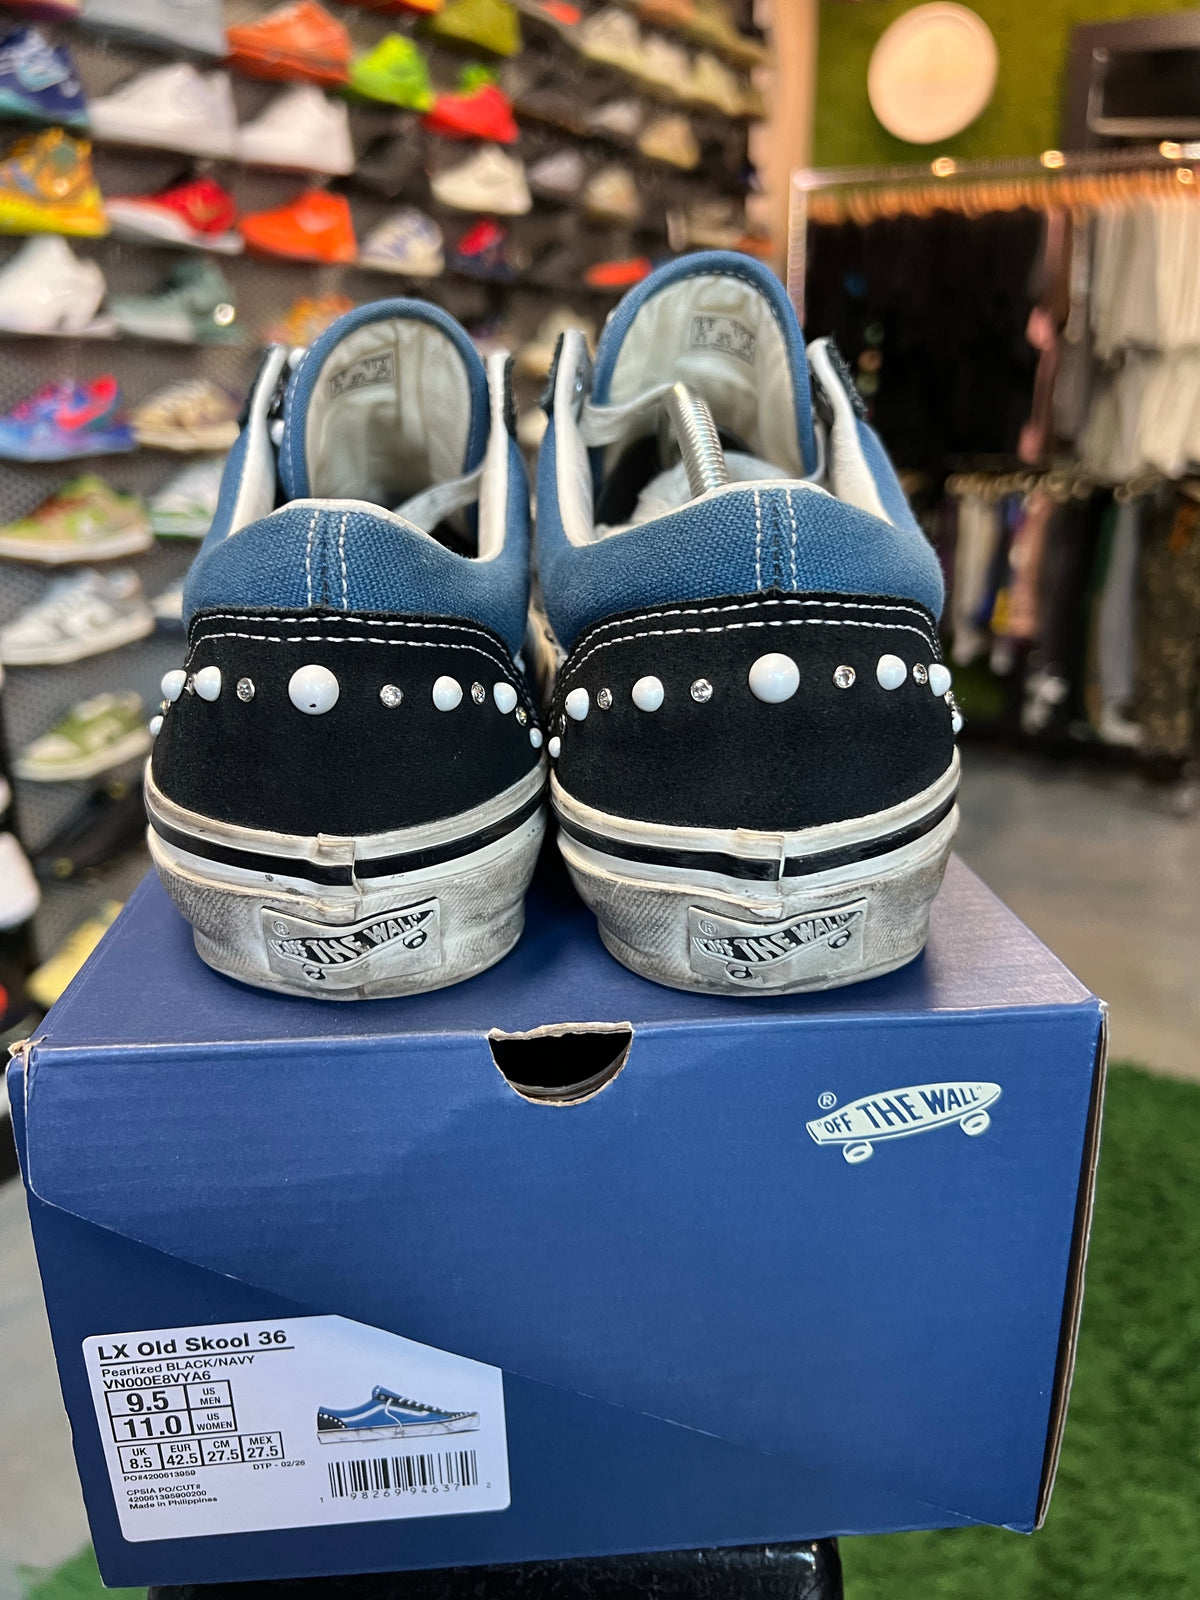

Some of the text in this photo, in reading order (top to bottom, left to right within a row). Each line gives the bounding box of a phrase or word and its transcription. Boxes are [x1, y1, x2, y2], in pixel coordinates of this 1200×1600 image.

[306, 935, 370, 964] THE
[735, 932, 797, 962] THE
[856, 1093, 923, 1129] THE
[97, 1330, 287, 1360] LX Old Skool 36
[102, 1355, 255, 1377] Pearlized BLACK/NAVY
[103, 1371, 211, 1389] VN000E8VYA6
[202, 1388, 215, 1396] US
[126, 1391, 169, 1412] 9.5
[200, 1396, 221, 1405] MEN
[207, 1413, 220, 1421] US
[124, 1415, 182, 1438] 11.0
[197, 1421, 233, 1431] WOMEN
[213, 1440, 230, 1449] CM
[250, 1436, 273, 1445] MEX
[132, 1448, 147, 1457] UK
[170, 1444, 191, 1453] EUR
[248, 1446, 278, 1459] 27.5
[166, 1453, 198, 1466] 42.5
[207, 1449, 239, 1462] 27.5
[129, 1458, 152, 1469] 8.5
[253, 1462, 272, 1470] DTP
[126, 1484, 201, 1496] CPSIA PO/CUT#
[129, 1496, 218, 1510] Made in Philippines
